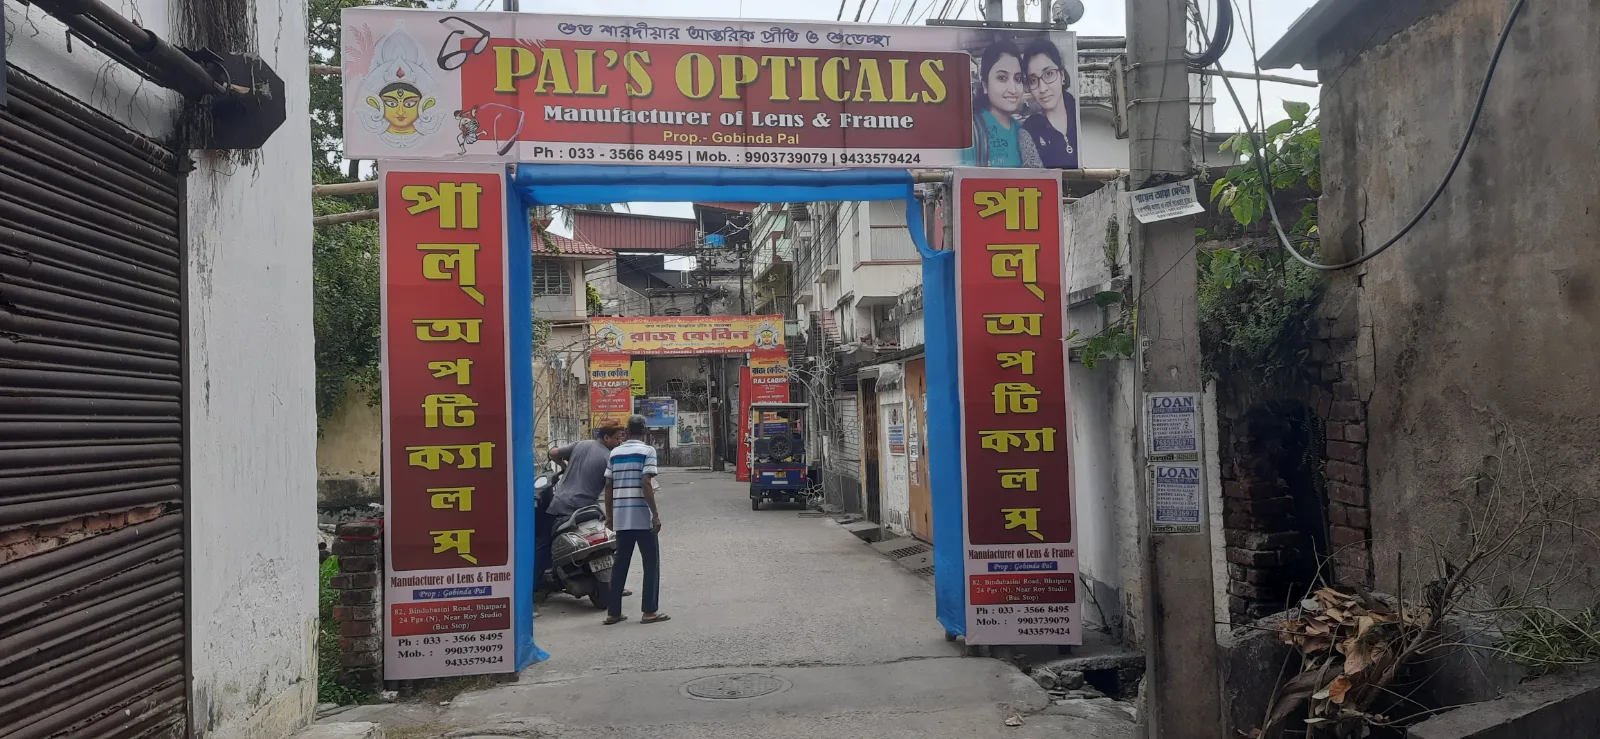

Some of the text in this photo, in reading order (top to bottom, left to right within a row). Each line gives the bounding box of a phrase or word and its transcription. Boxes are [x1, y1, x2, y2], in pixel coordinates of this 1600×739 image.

[557, 22, 891, 47] শুভ শারদীয়ার আন্তরিক প্রীতি ও শুভেচ্ছা
[492, 46, 948, 104] PAL'S OPTICALS
[543, 105, 914, 129] Manufacturer of Lens & Frame
[712, 131, 773, 145] Gobinda
[777, 133, 800, 145] Pal
[533, 147, 554, 158] Ph
[568, 148, 595, 160] 033
[609, 148, 644, 161] 3566
[648, 149, 683, 161] 8495
[696, 150, 731, 162] Mob.
[744, 152, 828, 164] 9903739079
[839, 152, 921, 165] 9433579424
[630, 327, 749, 343] রাজ কেবিন
[592, 370, 607, 379] রাজ
[752, 367, 766, 376] রাজ
[1152, 397, 1193, 408] LOAN
[1158, 467, 1199, 479] LOAN
[968, 547, 1075, 560] Manufacturer of Lens & Frame
[993, 563, 1008, 572] Prop
[1014, 562, 1040, 571] Gobinda
[1041, 561, 1053, 569] Pal
[390, 571, 511, 588] Manufacturer of Lens & Frame
[419, 589, 436, 599] Prop
[443, 587, 472, 597] Gobinda
[473, 586, 486, 595] Pal
[1033, 585, 1045, 593] Roy
[1005, 594, 1039, 602] (Bus Stop)
[394, 603, 507, 616] 82, Bindubasini Road, Bhatpara
[976, 607, 988, 615] Ph
[998, 606, 1014, 615] 033
[1024, 606, 1045, 614] 3566
[1047, 605, 1069, 613] 8495
[443, 613, 461, 621] Near
[463, 612, 477, 621] Roy
[480, 611, 503, 619] Studio
[976, 618, 1000, 626] Mob.
[1017, 616, 1070, 625] 9903739079
[432, 621, 470, 632] (Bus Stop)
[1018, 627, 1071, 636] 9433579424
[397, 638, 412, 647] Ph
[423, 636, 441, 645] 033
[452, 635, 476, 644] 3566
[479, 632, 503, 641] 8495
[397, 649, 425, 659] Mob.
[444, 643, 503, 655] 9903739079
[444, 655, 504, 667] 9433579424
